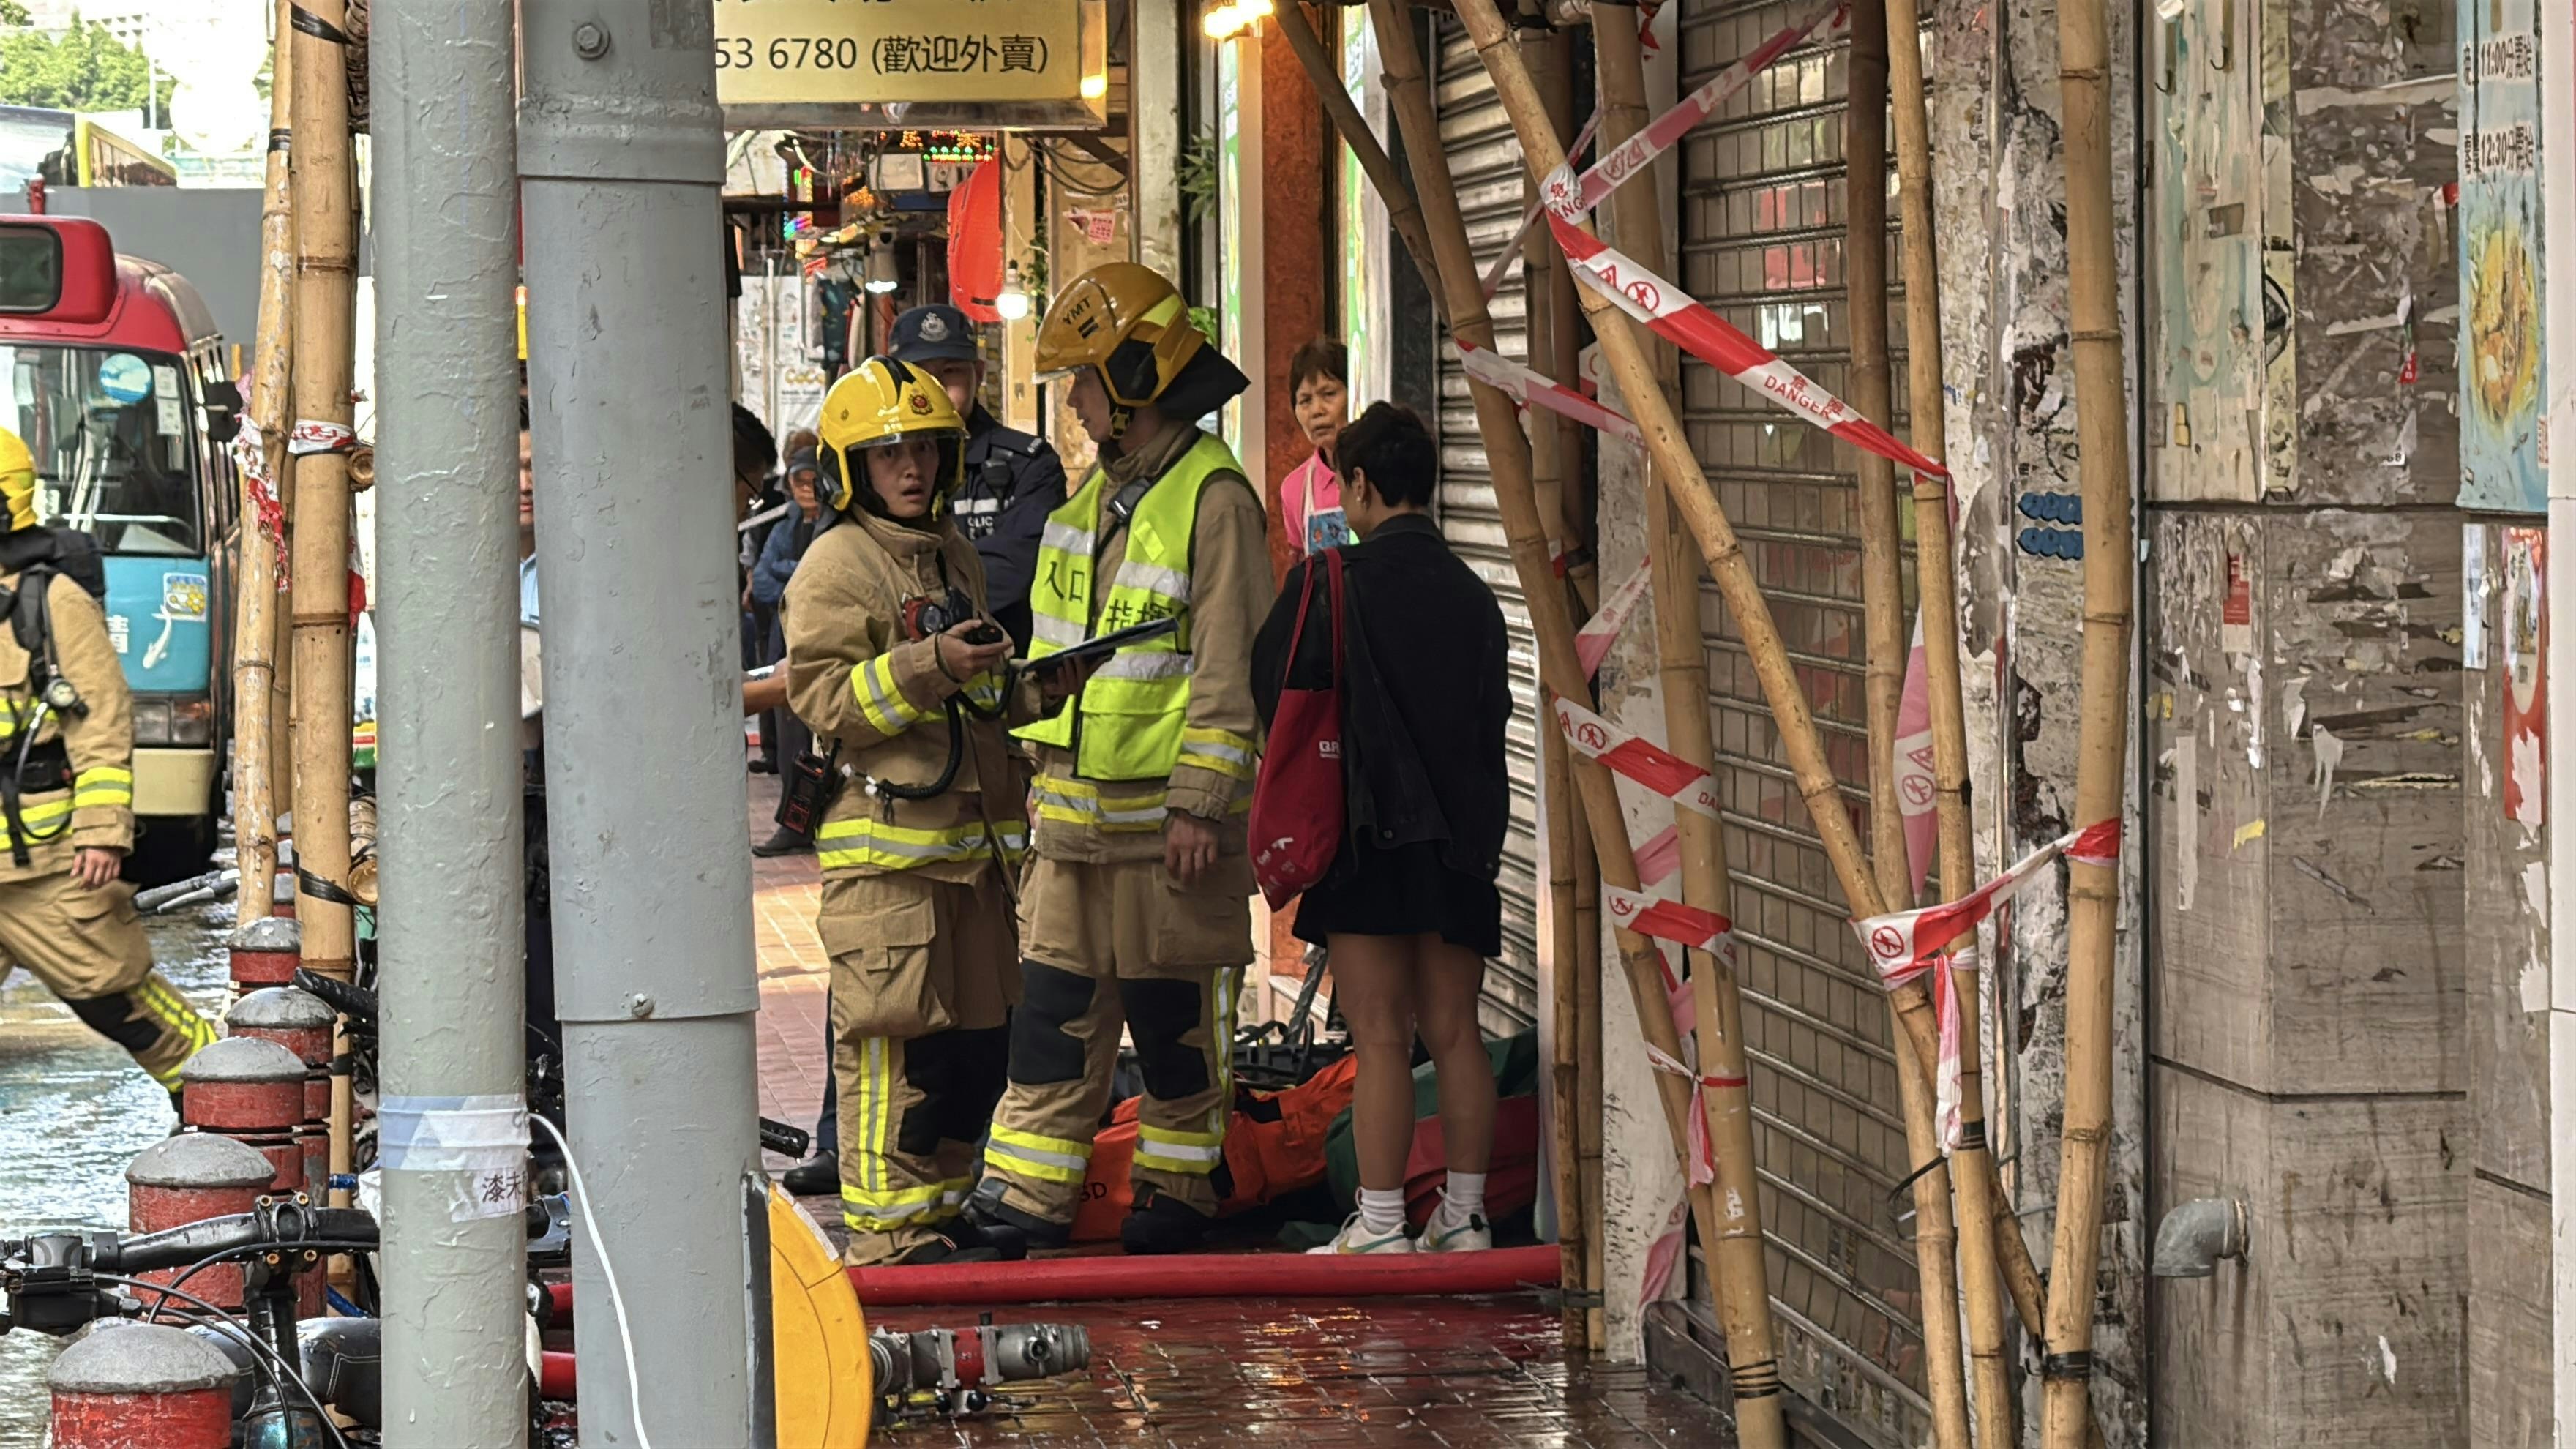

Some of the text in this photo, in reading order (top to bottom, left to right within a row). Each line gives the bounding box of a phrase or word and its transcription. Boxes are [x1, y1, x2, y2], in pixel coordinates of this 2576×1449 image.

[768, 37, 857, 69] 6780
[871, 35, 1048, 75] (歡迎外賣)
[1063, 296, 1090, 325] YMT
[1764, 374, 1830, 419] DANGER
